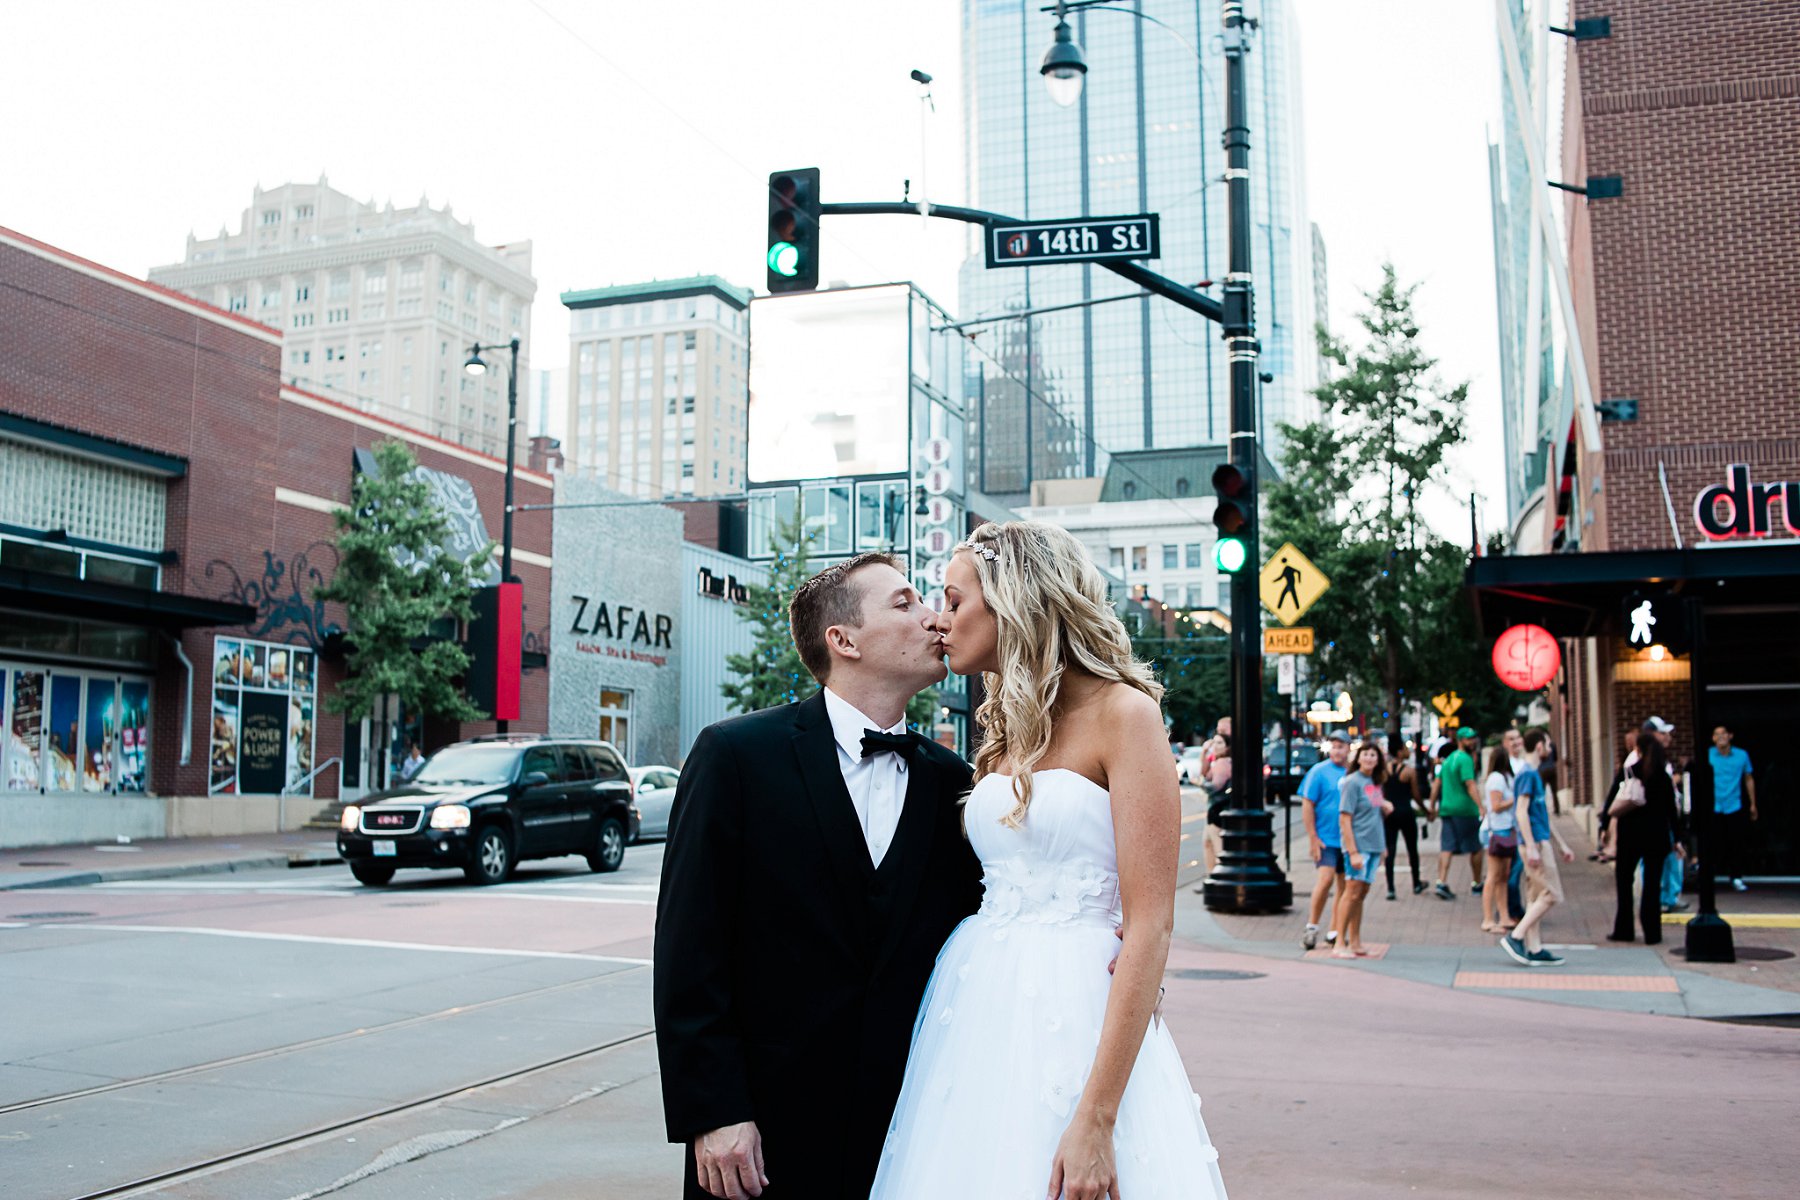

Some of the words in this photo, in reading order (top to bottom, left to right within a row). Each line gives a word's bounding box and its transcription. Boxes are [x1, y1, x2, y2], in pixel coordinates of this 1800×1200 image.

[1038, 226, 1099, 254] 14th
[1112, 225, 1141, 251] St
[570, 595, 672, 649] ZAFAR
[1268, 634, 1310, 648] AHEAD
[243, 726, 281, 742] POWER
